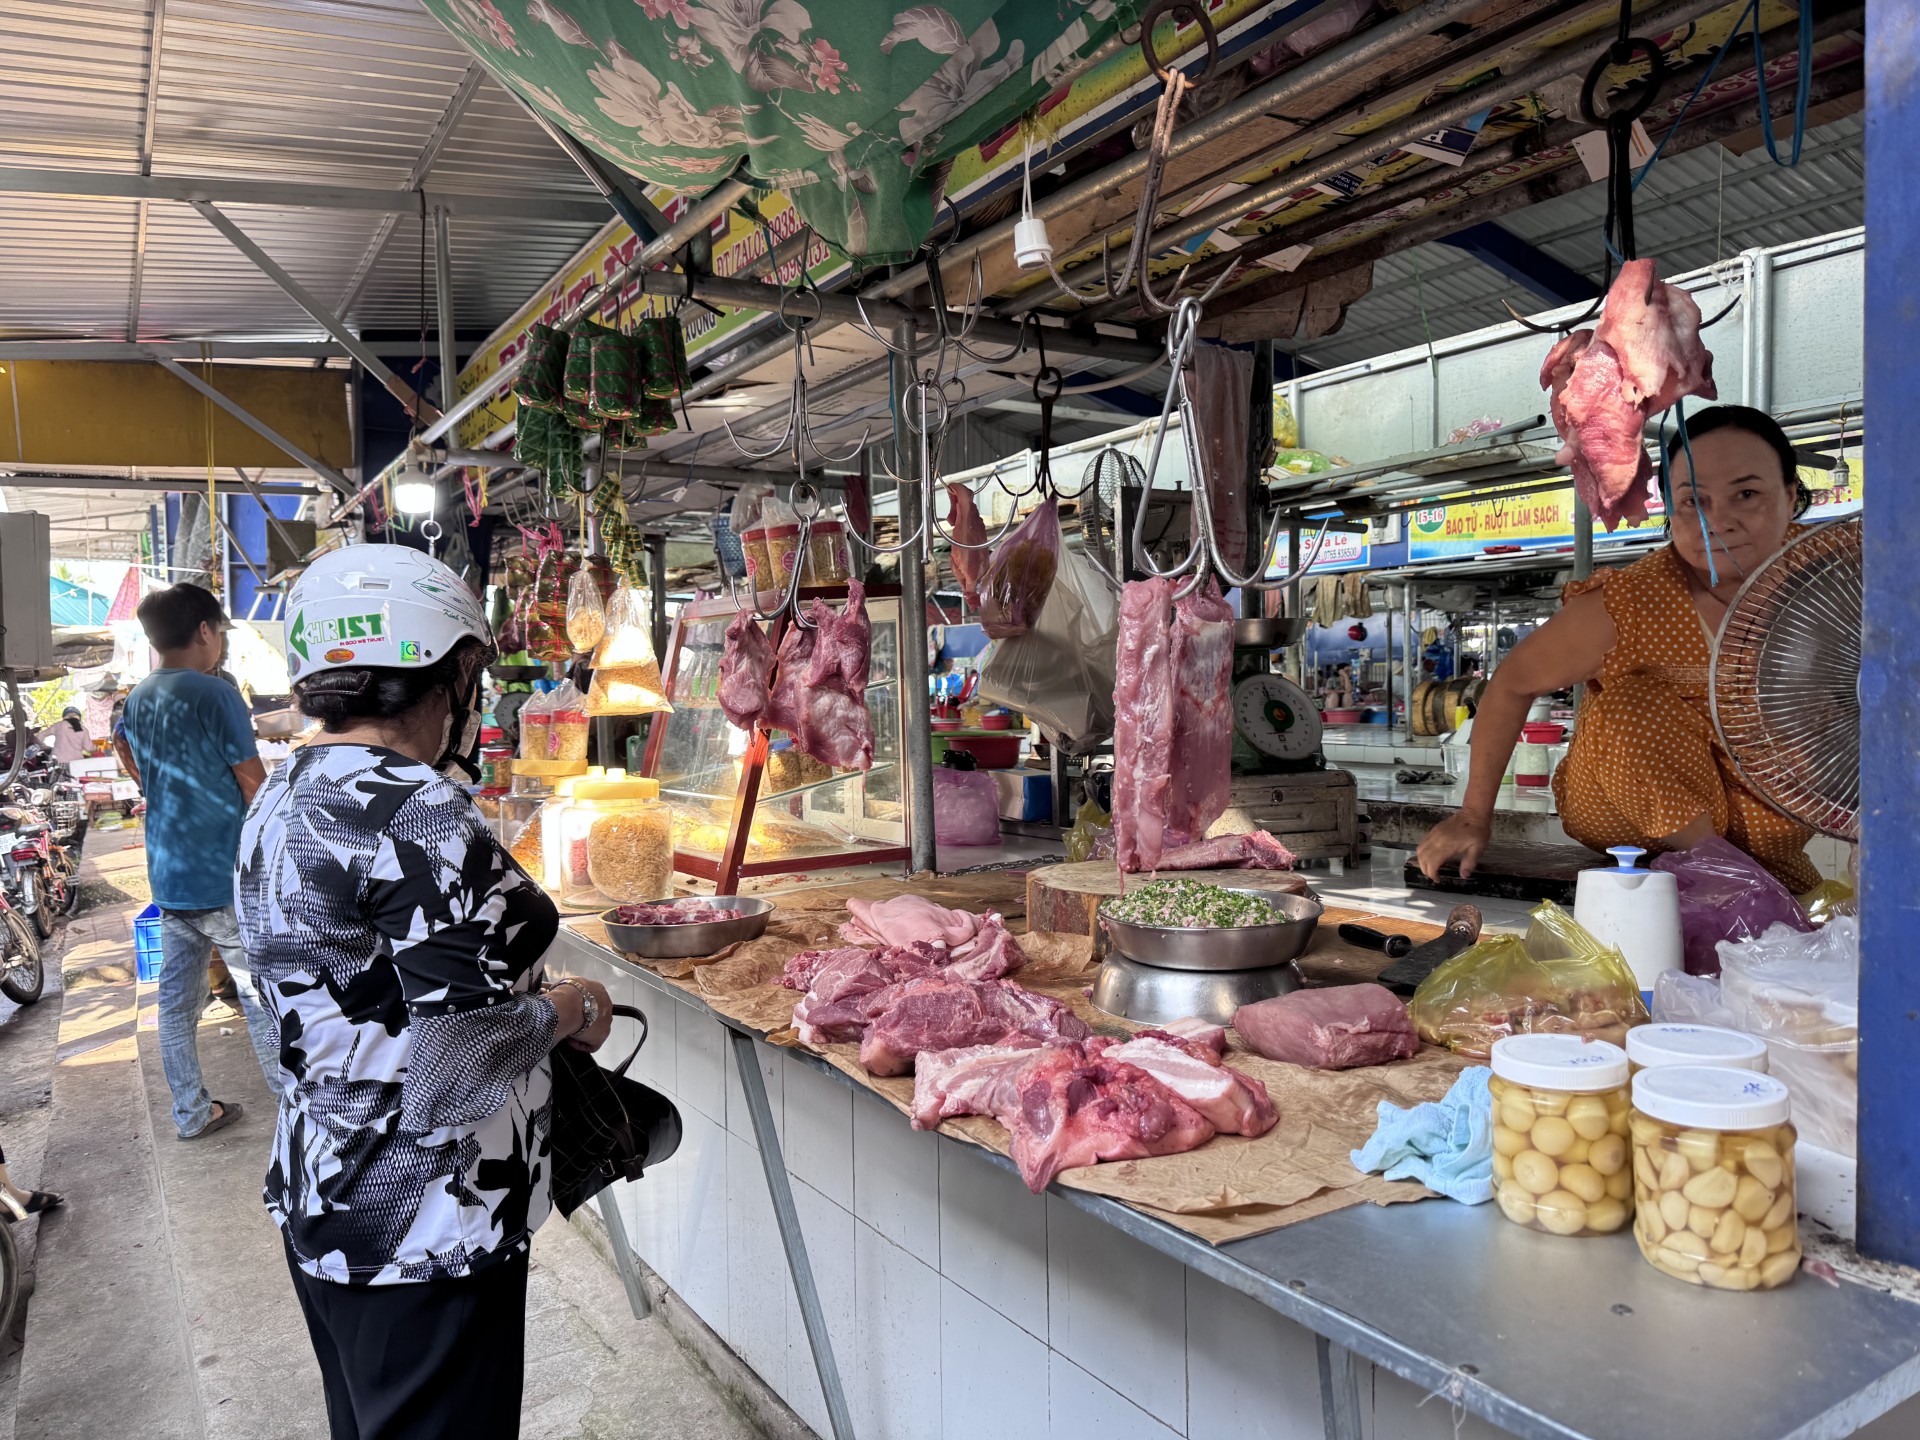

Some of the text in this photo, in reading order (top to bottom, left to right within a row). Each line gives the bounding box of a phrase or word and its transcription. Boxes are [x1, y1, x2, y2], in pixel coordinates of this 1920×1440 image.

[1446, 519, 1463, 536] BAO
[1534, 505, 1559, 530] SẠCH
[303, 613, 384, 644] CHRIST
